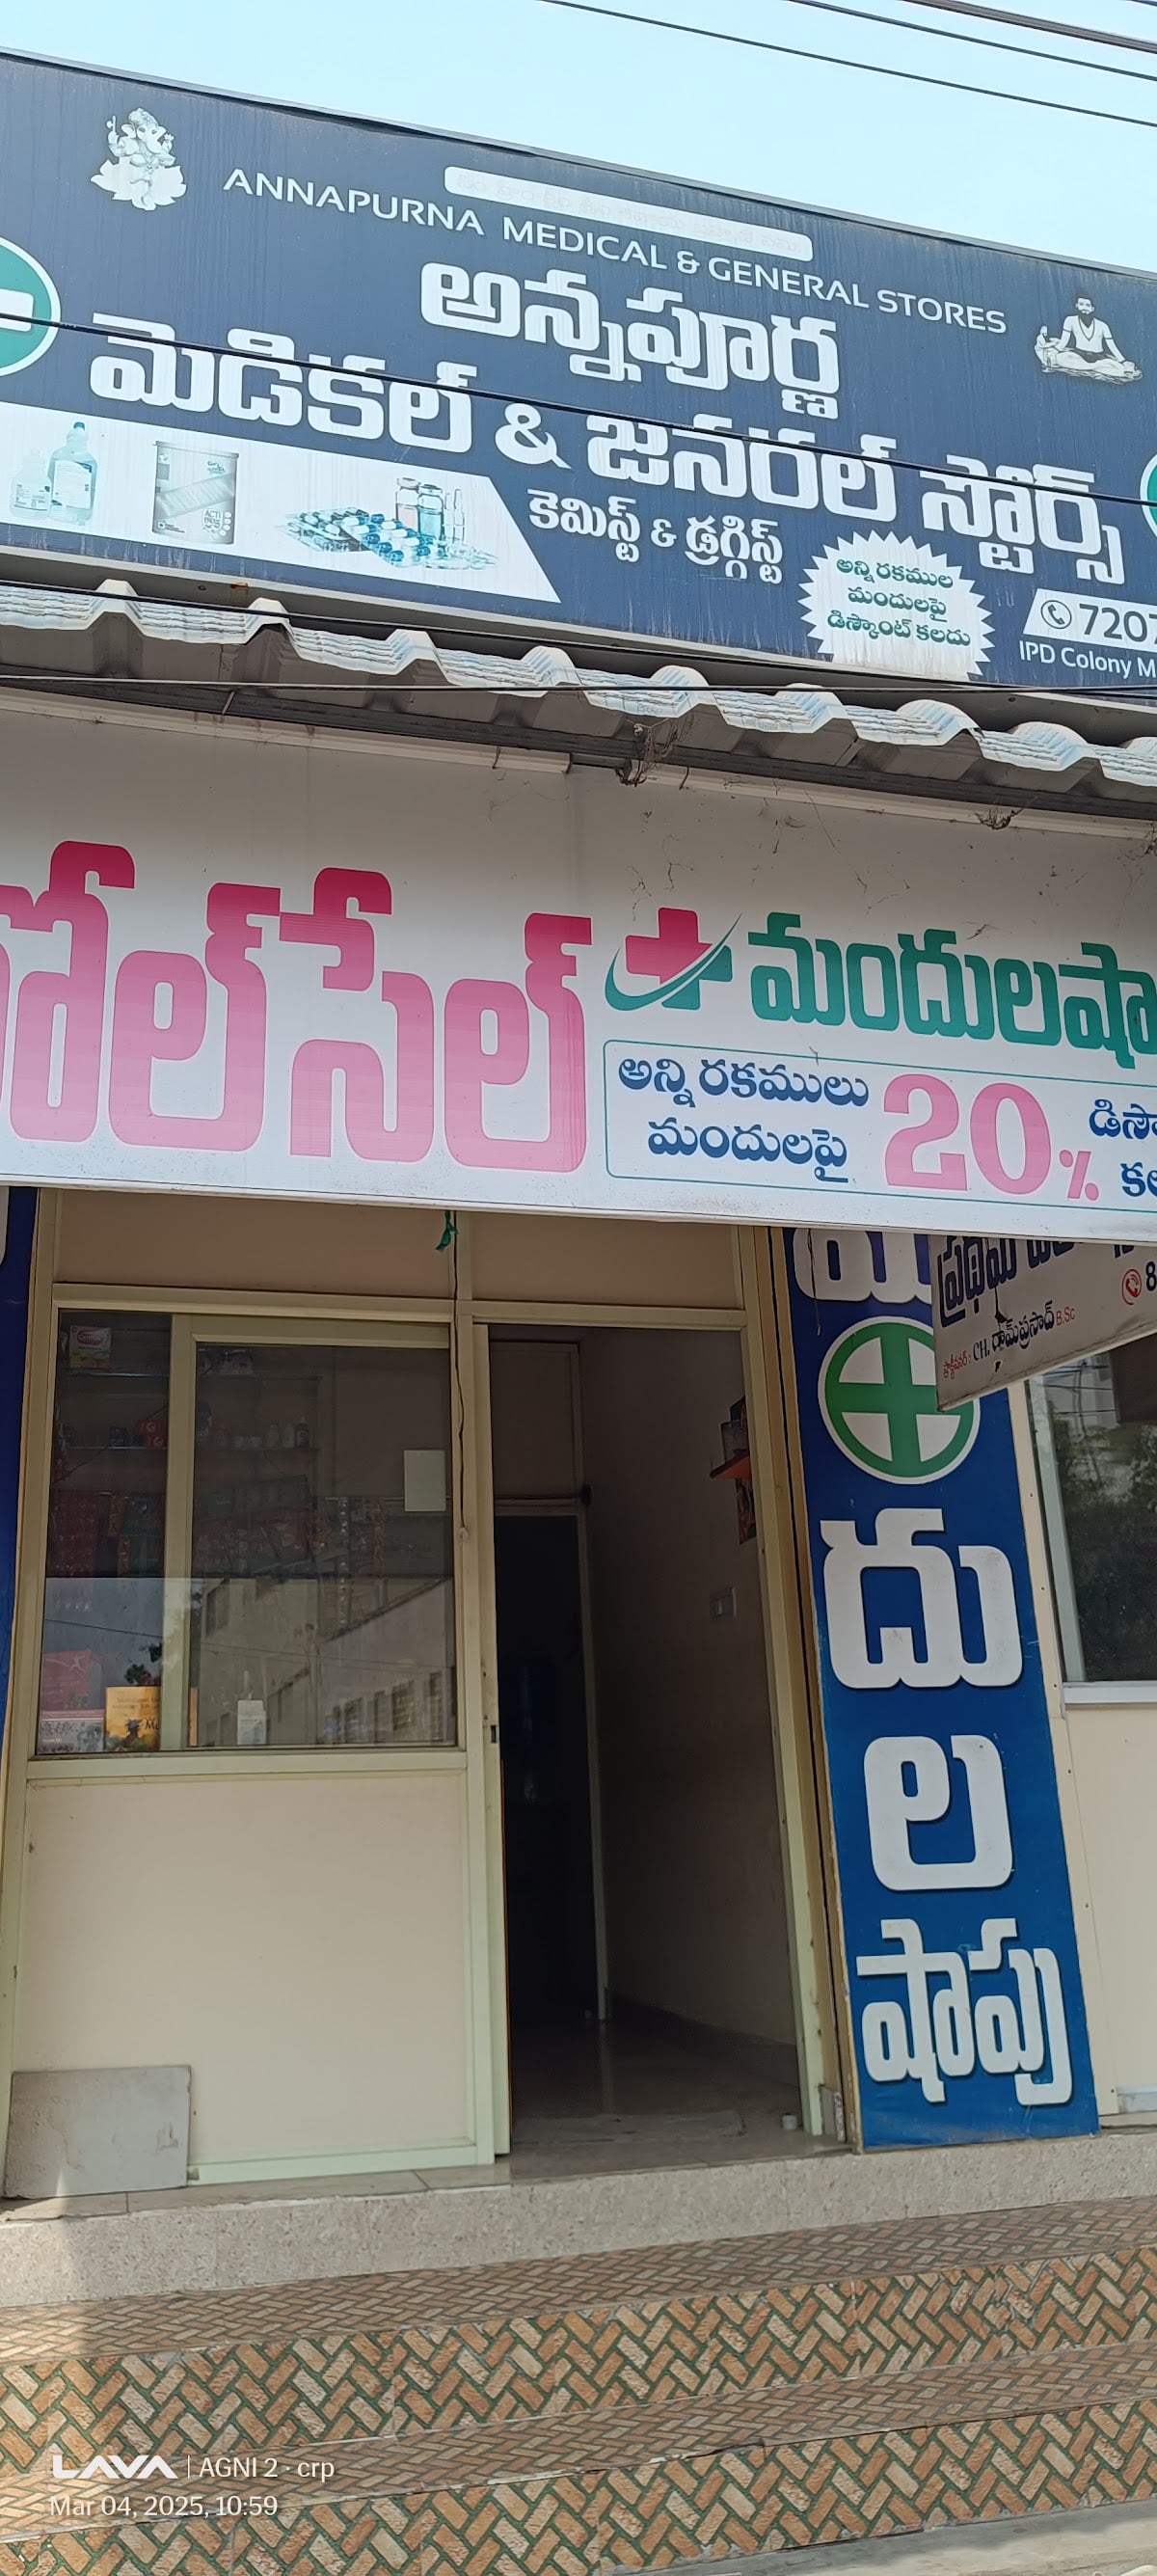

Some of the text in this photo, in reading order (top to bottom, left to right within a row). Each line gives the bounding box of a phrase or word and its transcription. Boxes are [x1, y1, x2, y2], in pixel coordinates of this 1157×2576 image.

[224, 168, 485, 236] ANNAPURNA
[502, 215, 668, 271] MEDICAL
[677, 249, 701, 274] &
[708, 257, 870, 309] GENERAL
[877, 289, 1008, 335] STORES
[419, 261, 841, 420] అన్నపూర్ణ
[90, 312, 478, 454] మెడికల్
[493, 402, 572, 470] &
[585, 413, 899, 523] జనరల్
[527, 488, 641, 562] కెమిస్ట్
[650, 518, 677, 548] &
[836, 558, 875, 583] అన్ని
[848, 586, 948, 623] మందులపై
[916, 623, 971, 647] కలదు
[1019, 640, 1056, 664] IPD
[1061, 647, 1132, 679] Colony
[618, 1057, 869, 1109] అన్ని రకములు
[647, 1117, 849, 1184] మందులపై
